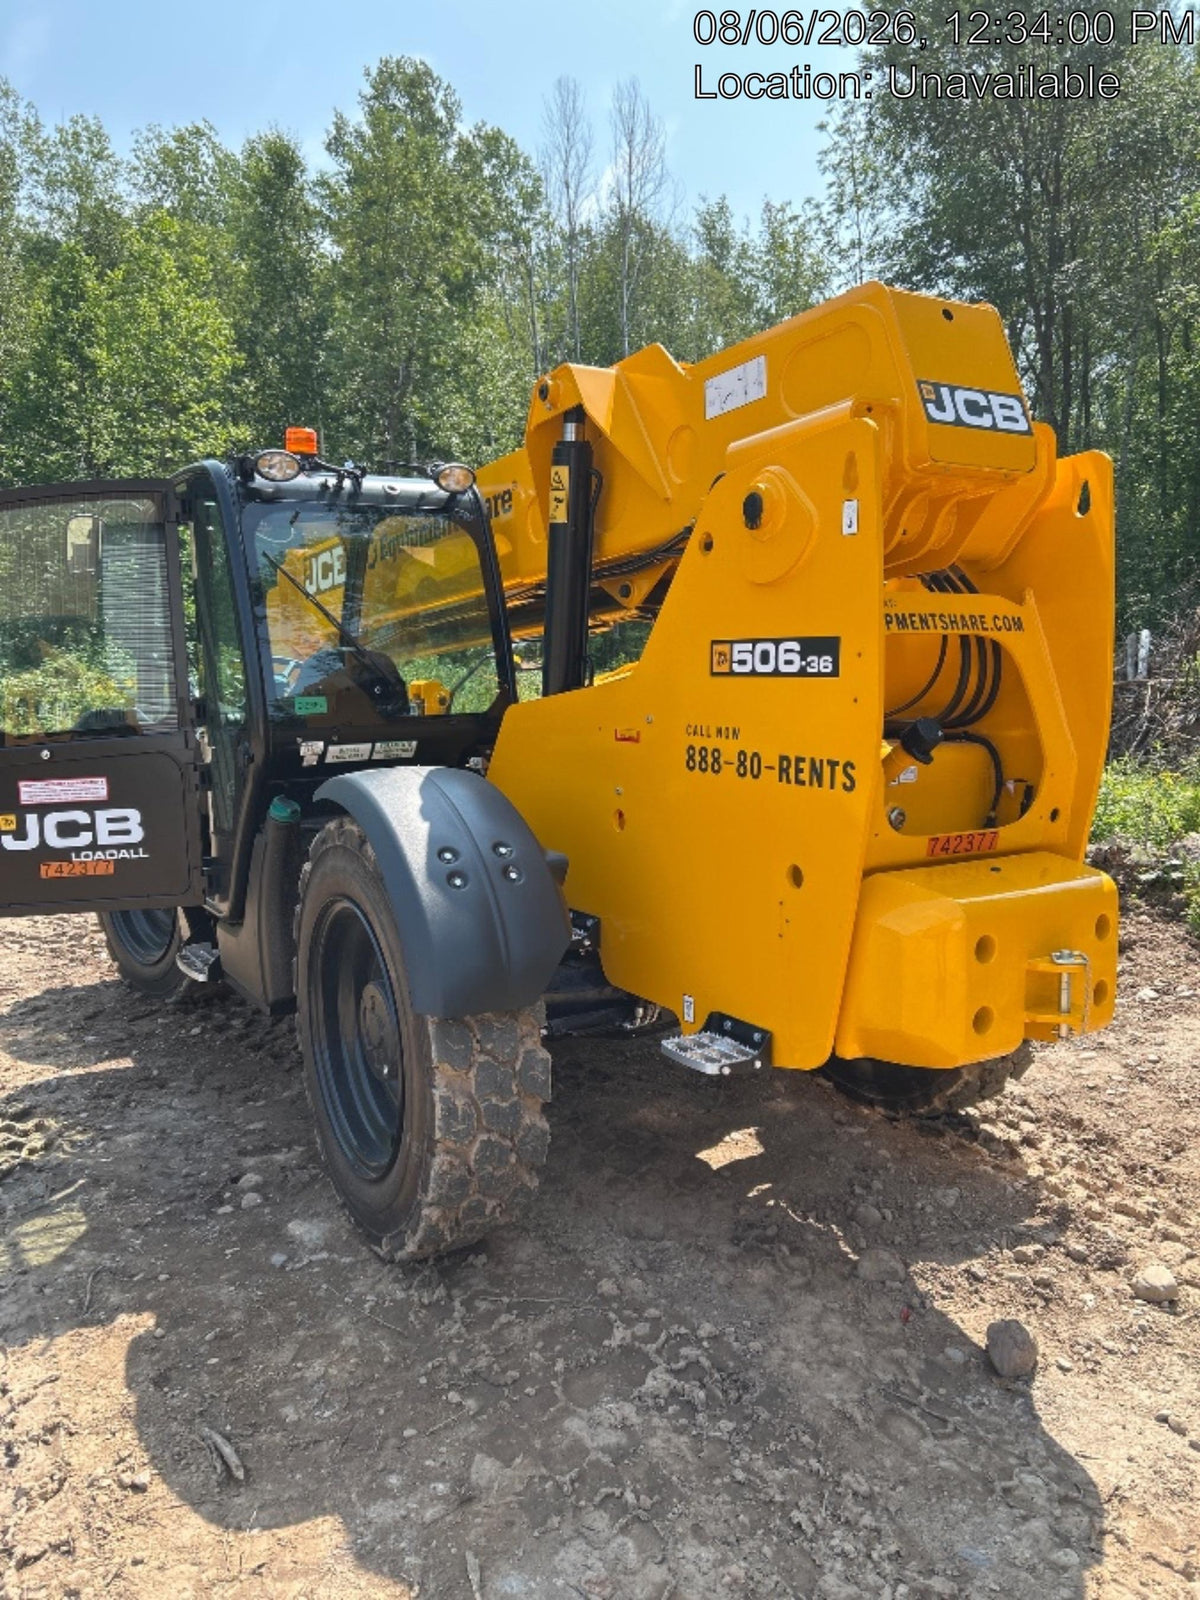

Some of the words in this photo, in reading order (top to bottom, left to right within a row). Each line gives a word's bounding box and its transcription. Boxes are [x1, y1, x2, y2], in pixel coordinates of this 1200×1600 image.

[925, 386, 1029, 431] JCB
[686, 724, 711, 738] CALL
[685, 744, 856, 793] 888-80-RENTS
[1, 808, 144, 850] JCB
[71, 848, 150, 862] LOADALL
[928, 831, 997, 857] 742377
[42, 860, 111, 877] 742377
